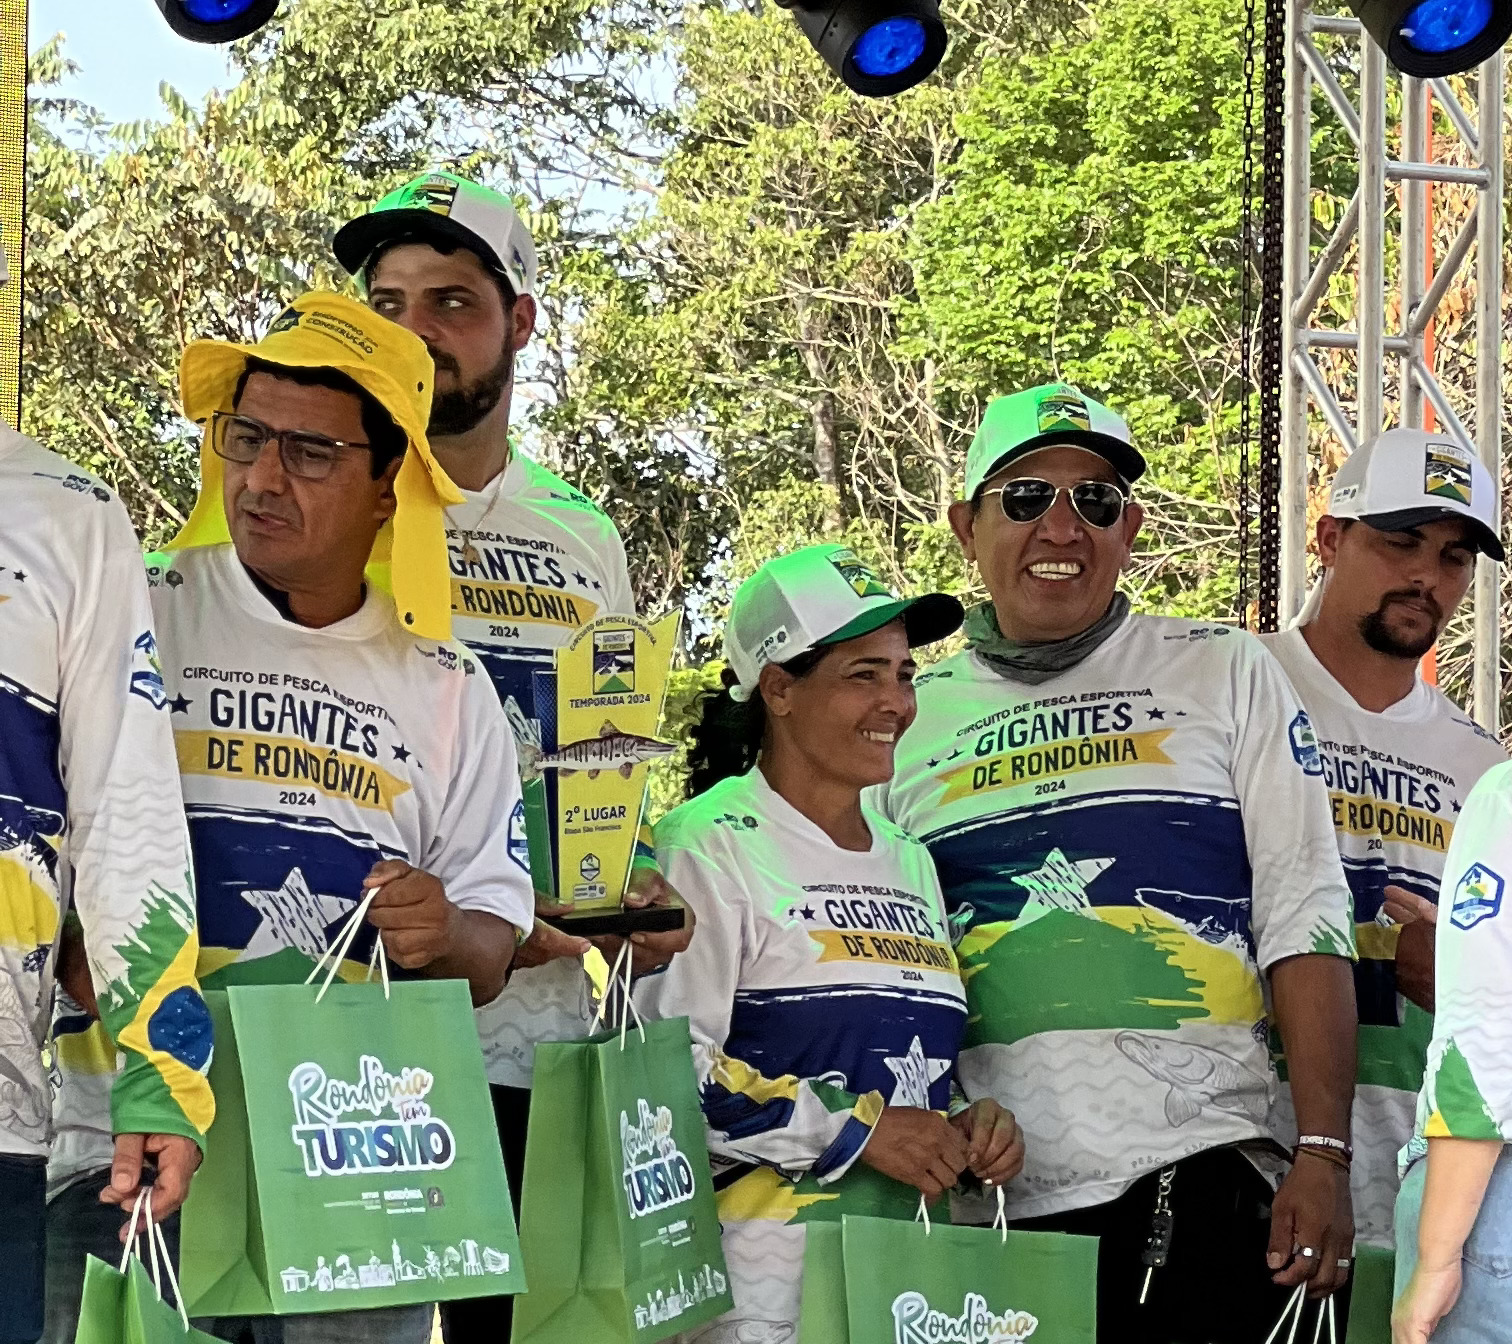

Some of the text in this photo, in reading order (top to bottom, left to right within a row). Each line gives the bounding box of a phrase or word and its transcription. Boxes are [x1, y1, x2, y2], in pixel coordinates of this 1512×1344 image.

[447, 545, 567, 589] GANTES
[460, 584, 582, 625] RONDÔNIA
[488, 624, 520, 639] 2024
[182, 667, 331, 696] CIRCUITO DE PESCA
[569, 693, 651, 709] TEMPORADA 2024
[956, 687, 1154, 737] CIRCUITO DE PESCA ESPORTIVA
[209, 687, 380, 759] GIGANTES
[974, 702, 1134, 758] GIGANTES
[972, 736, 1139, 791] DE RONDÔNIA
[1342, 744, 1358, 756] DE
[207, 737, 381, 805] DE RONDÔNIA
[1034, 779, 1067, 796] 2024
[1320, 753, 1442, 814] GIGANTES
[279, 791, 317, 806] 2024
[583, 805, 627, 822] LUGAR
[1331, 798, 1344, 827] E
[846, 884, 861, 895] DE
[862, 886, 892, 897] PESCA
[823, 899, 936, 940] GIGANTES
[841, 934, 952, 970] DE RONDÔNIA
[900, 970, 924, 982] 2024
[293, 1120, 455, 1176] TURISMO
[623, 1152, 695, 1219] TURISMO
